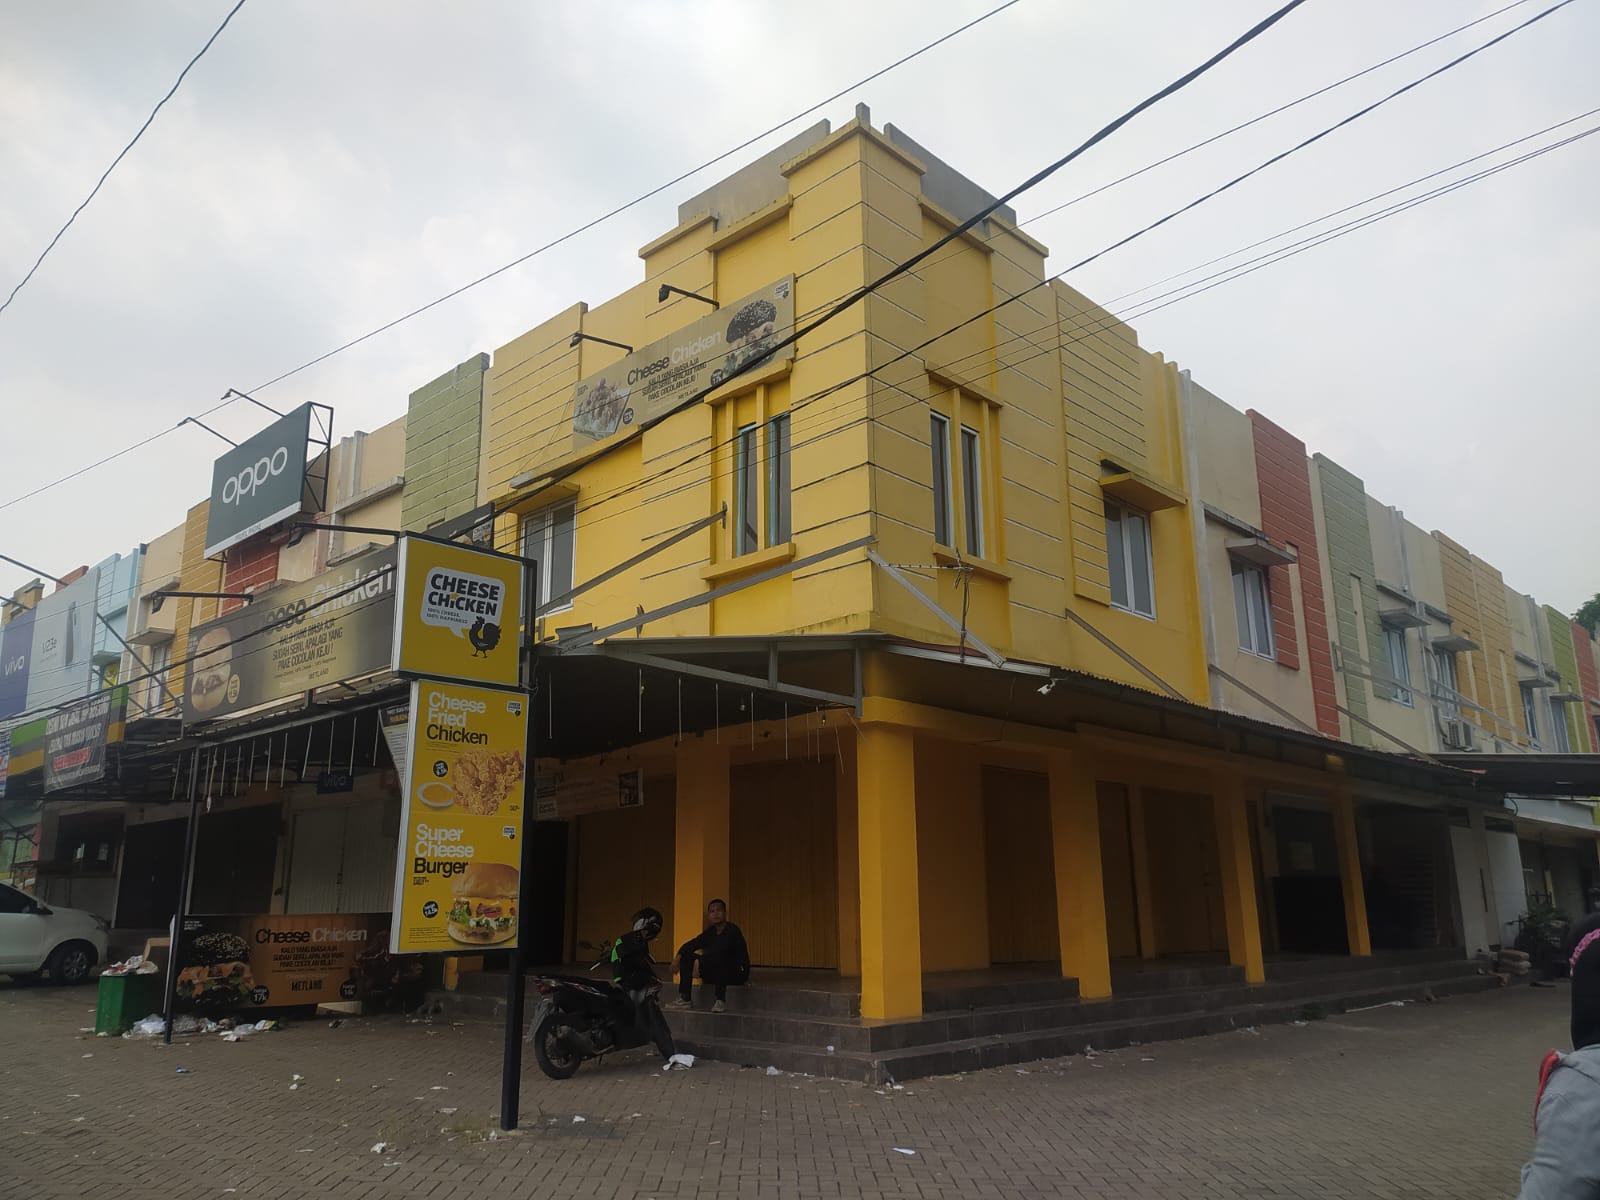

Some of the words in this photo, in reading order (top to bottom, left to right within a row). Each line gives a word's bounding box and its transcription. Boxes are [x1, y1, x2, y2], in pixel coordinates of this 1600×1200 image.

[627, 356, 670, 385] Cheese
[671, 331, 721, 364] Chicken
[222, 446, 288, 506] oppo
[310, 562, 393, 618] Chicken
[430, 573, 500, 601] CHEESE
[5, 655, 25, 676] vivo
[428, 691, 487, 714] Cheese
[428, 707, 467, 727] Fried
[426, 724, 488, 745] Chicken
[415, 823, 465, 844] Super
[414, 840, 475, 858] Cheese
[413, 857, 468, 879] Burger
[255, 928, 311, 944] Cheese
[312, 928, 367, 942] Chicken
[291, 979, 322, 992] METLAND
